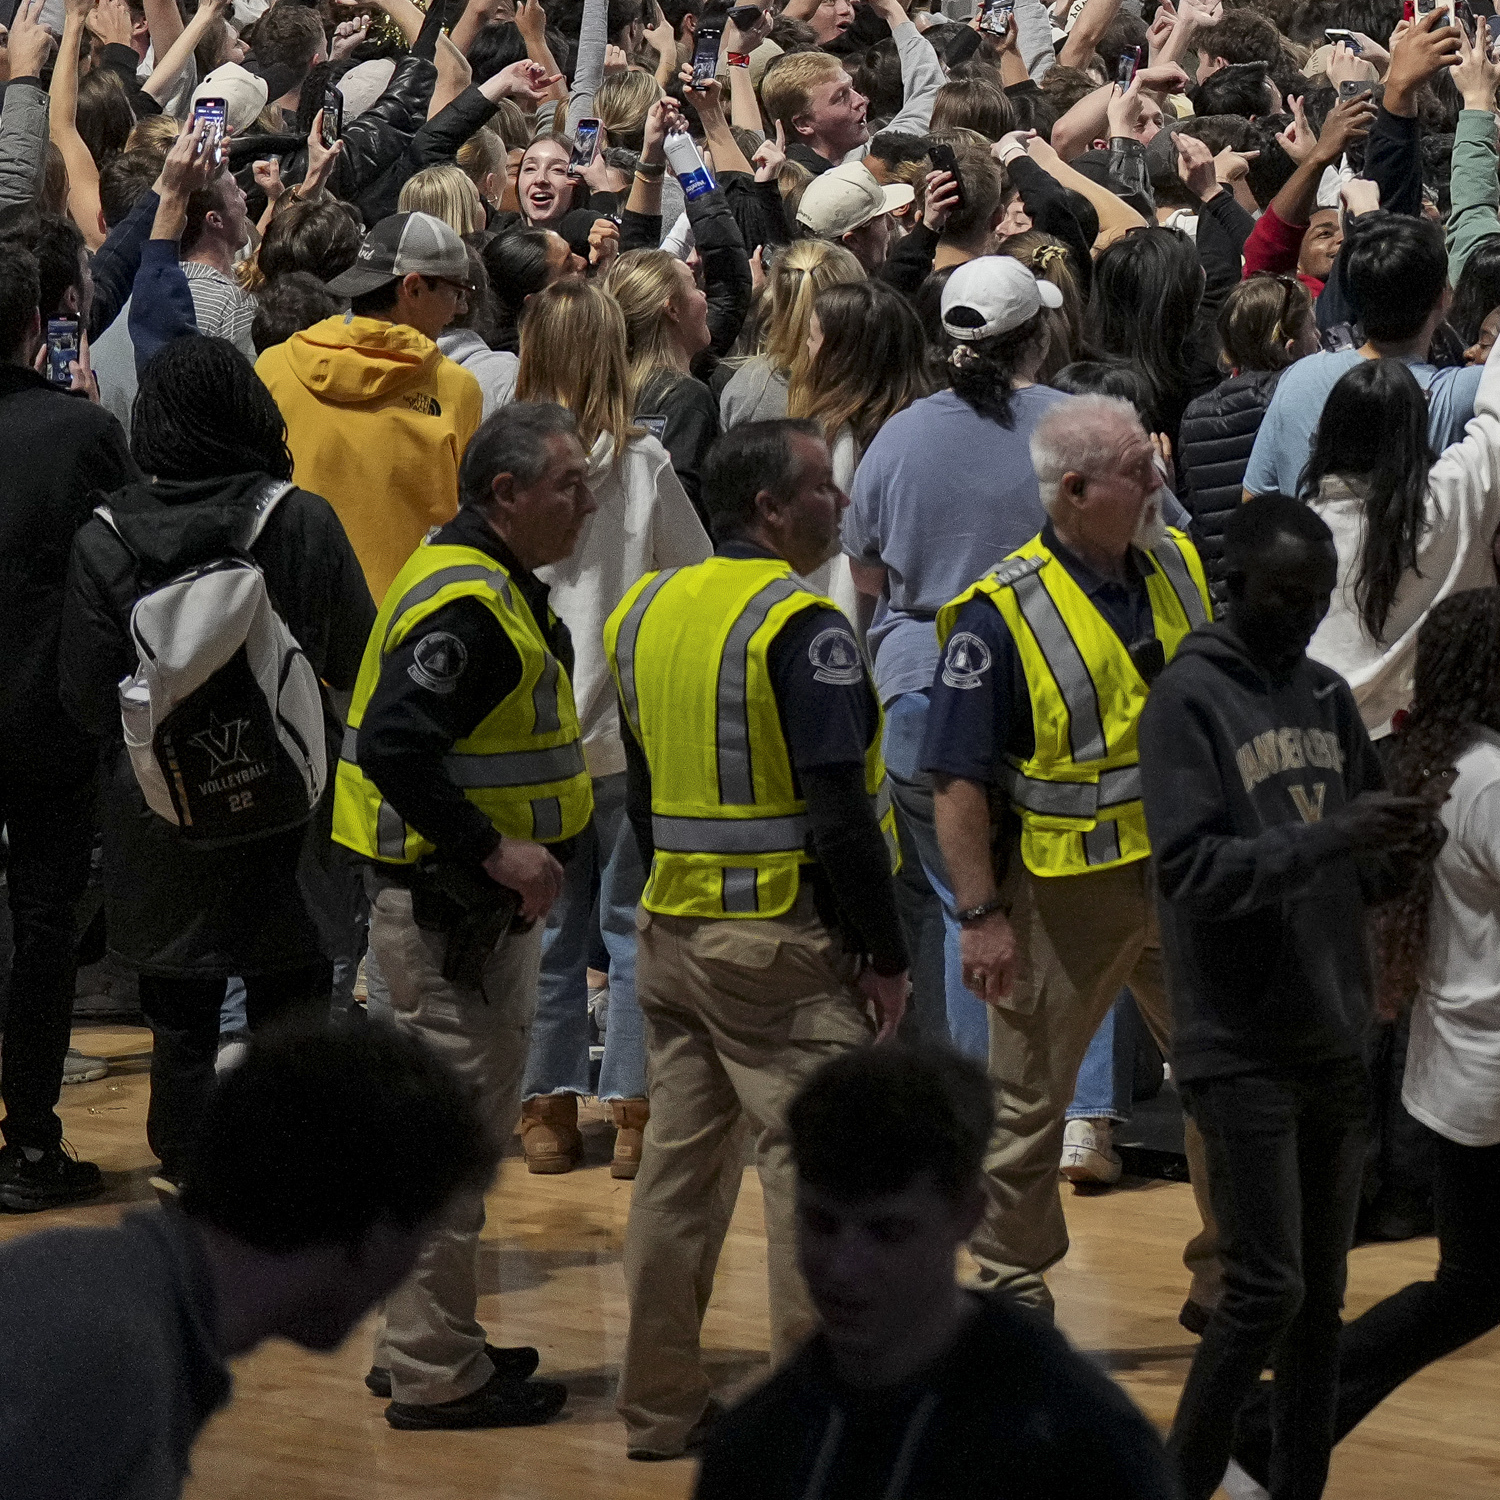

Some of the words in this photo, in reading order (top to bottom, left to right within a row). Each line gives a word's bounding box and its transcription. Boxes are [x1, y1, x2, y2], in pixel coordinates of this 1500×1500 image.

[198, 764, 270, 797] VOLLEYBALL
[228, 790, 256, 814] 22
[1286, 782, 1327, 824] V
